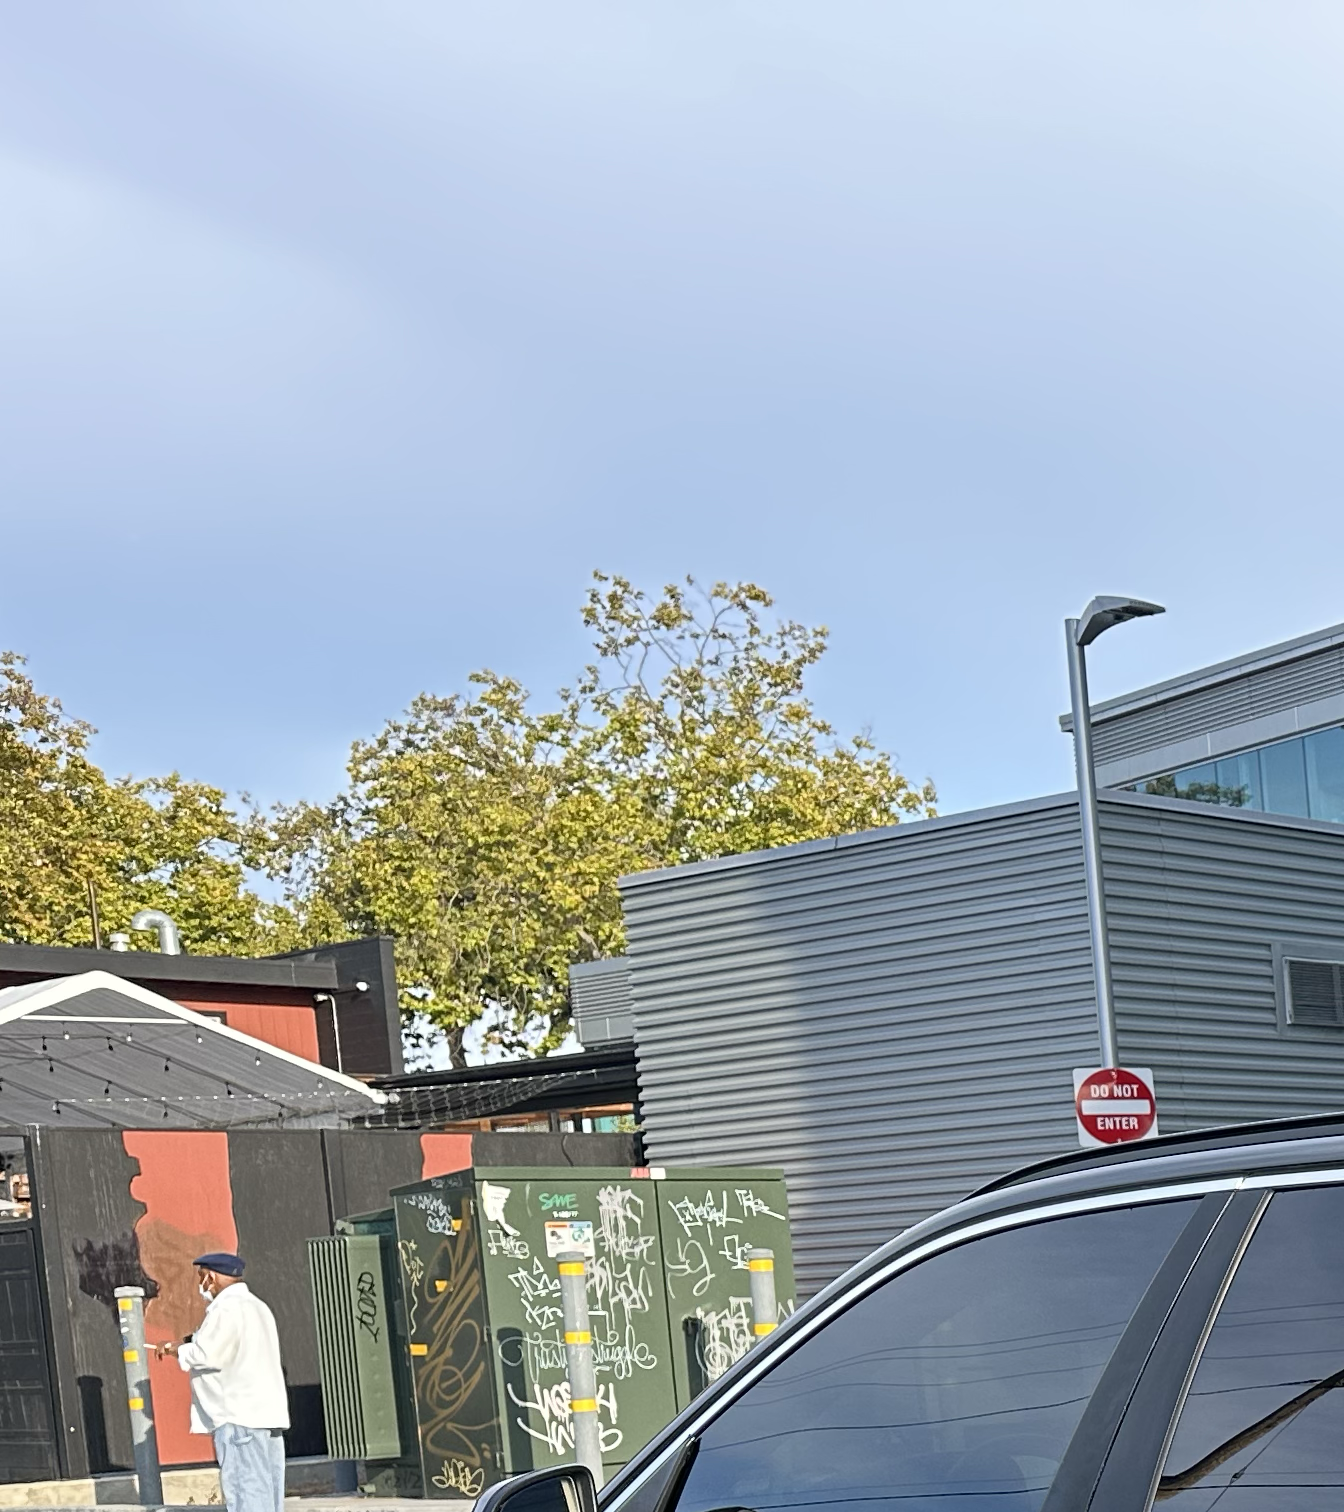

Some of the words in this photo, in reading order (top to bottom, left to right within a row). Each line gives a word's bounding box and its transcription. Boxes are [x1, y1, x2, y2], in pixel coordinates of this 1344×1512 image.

[1090, 1084, 1109, 1098] DO
[1113, 1084, 1139, 1098] NOT
[1096, 1116, 1139, 1131] ENTER
